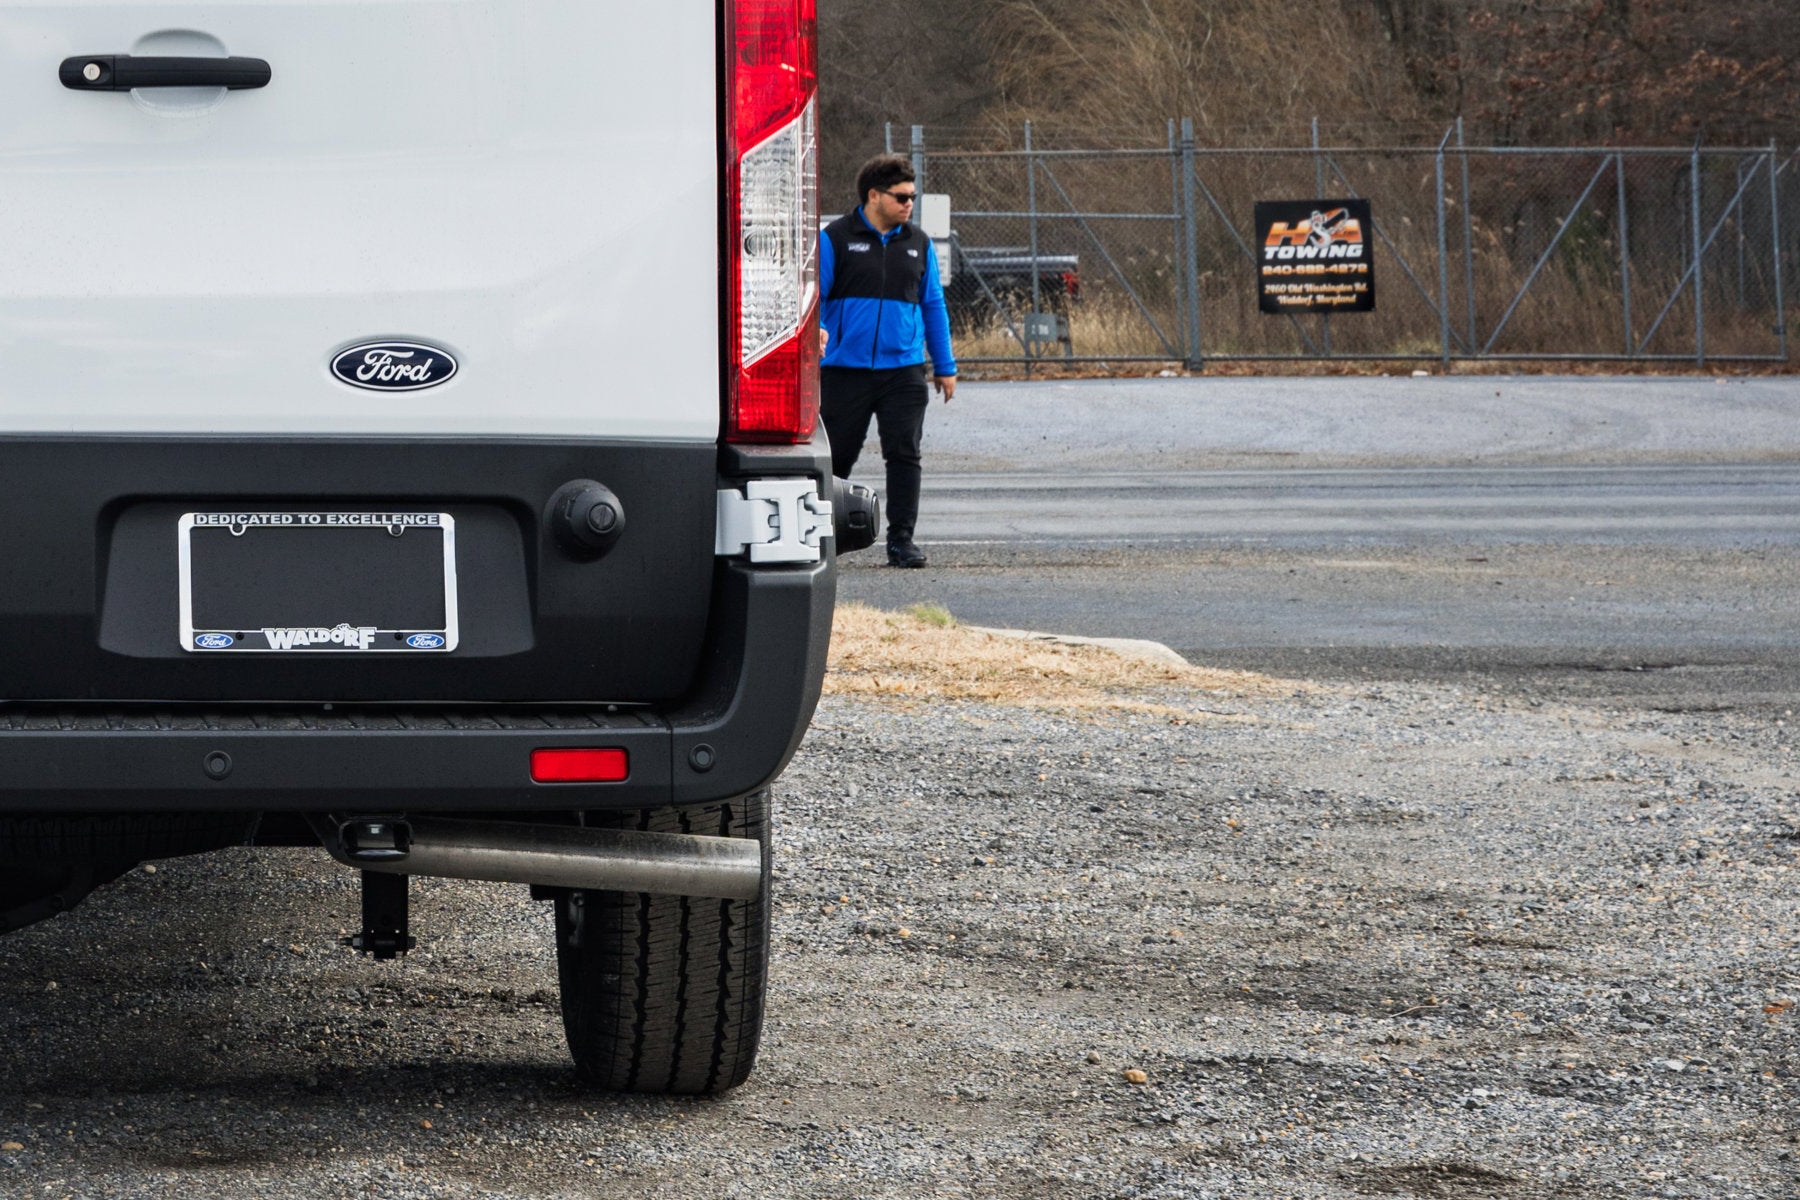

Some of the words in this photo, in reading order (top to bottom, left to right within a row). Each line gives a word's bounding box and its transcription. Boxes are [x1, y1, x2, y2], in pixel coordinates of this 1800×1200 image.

[1264, 244, 1364, 259] TOWING
[356, 349, 434, 382] Ford
[196, 513, 293, 525] DEDICATED
[298, 513, 321, 525] TO
[326, 513, 439, 525] EXCELLENCE
[201, 634, 227, 646] Ford
[263, 627, 376, 649] WALDORF
[413, 634, 439, 646] Ford
